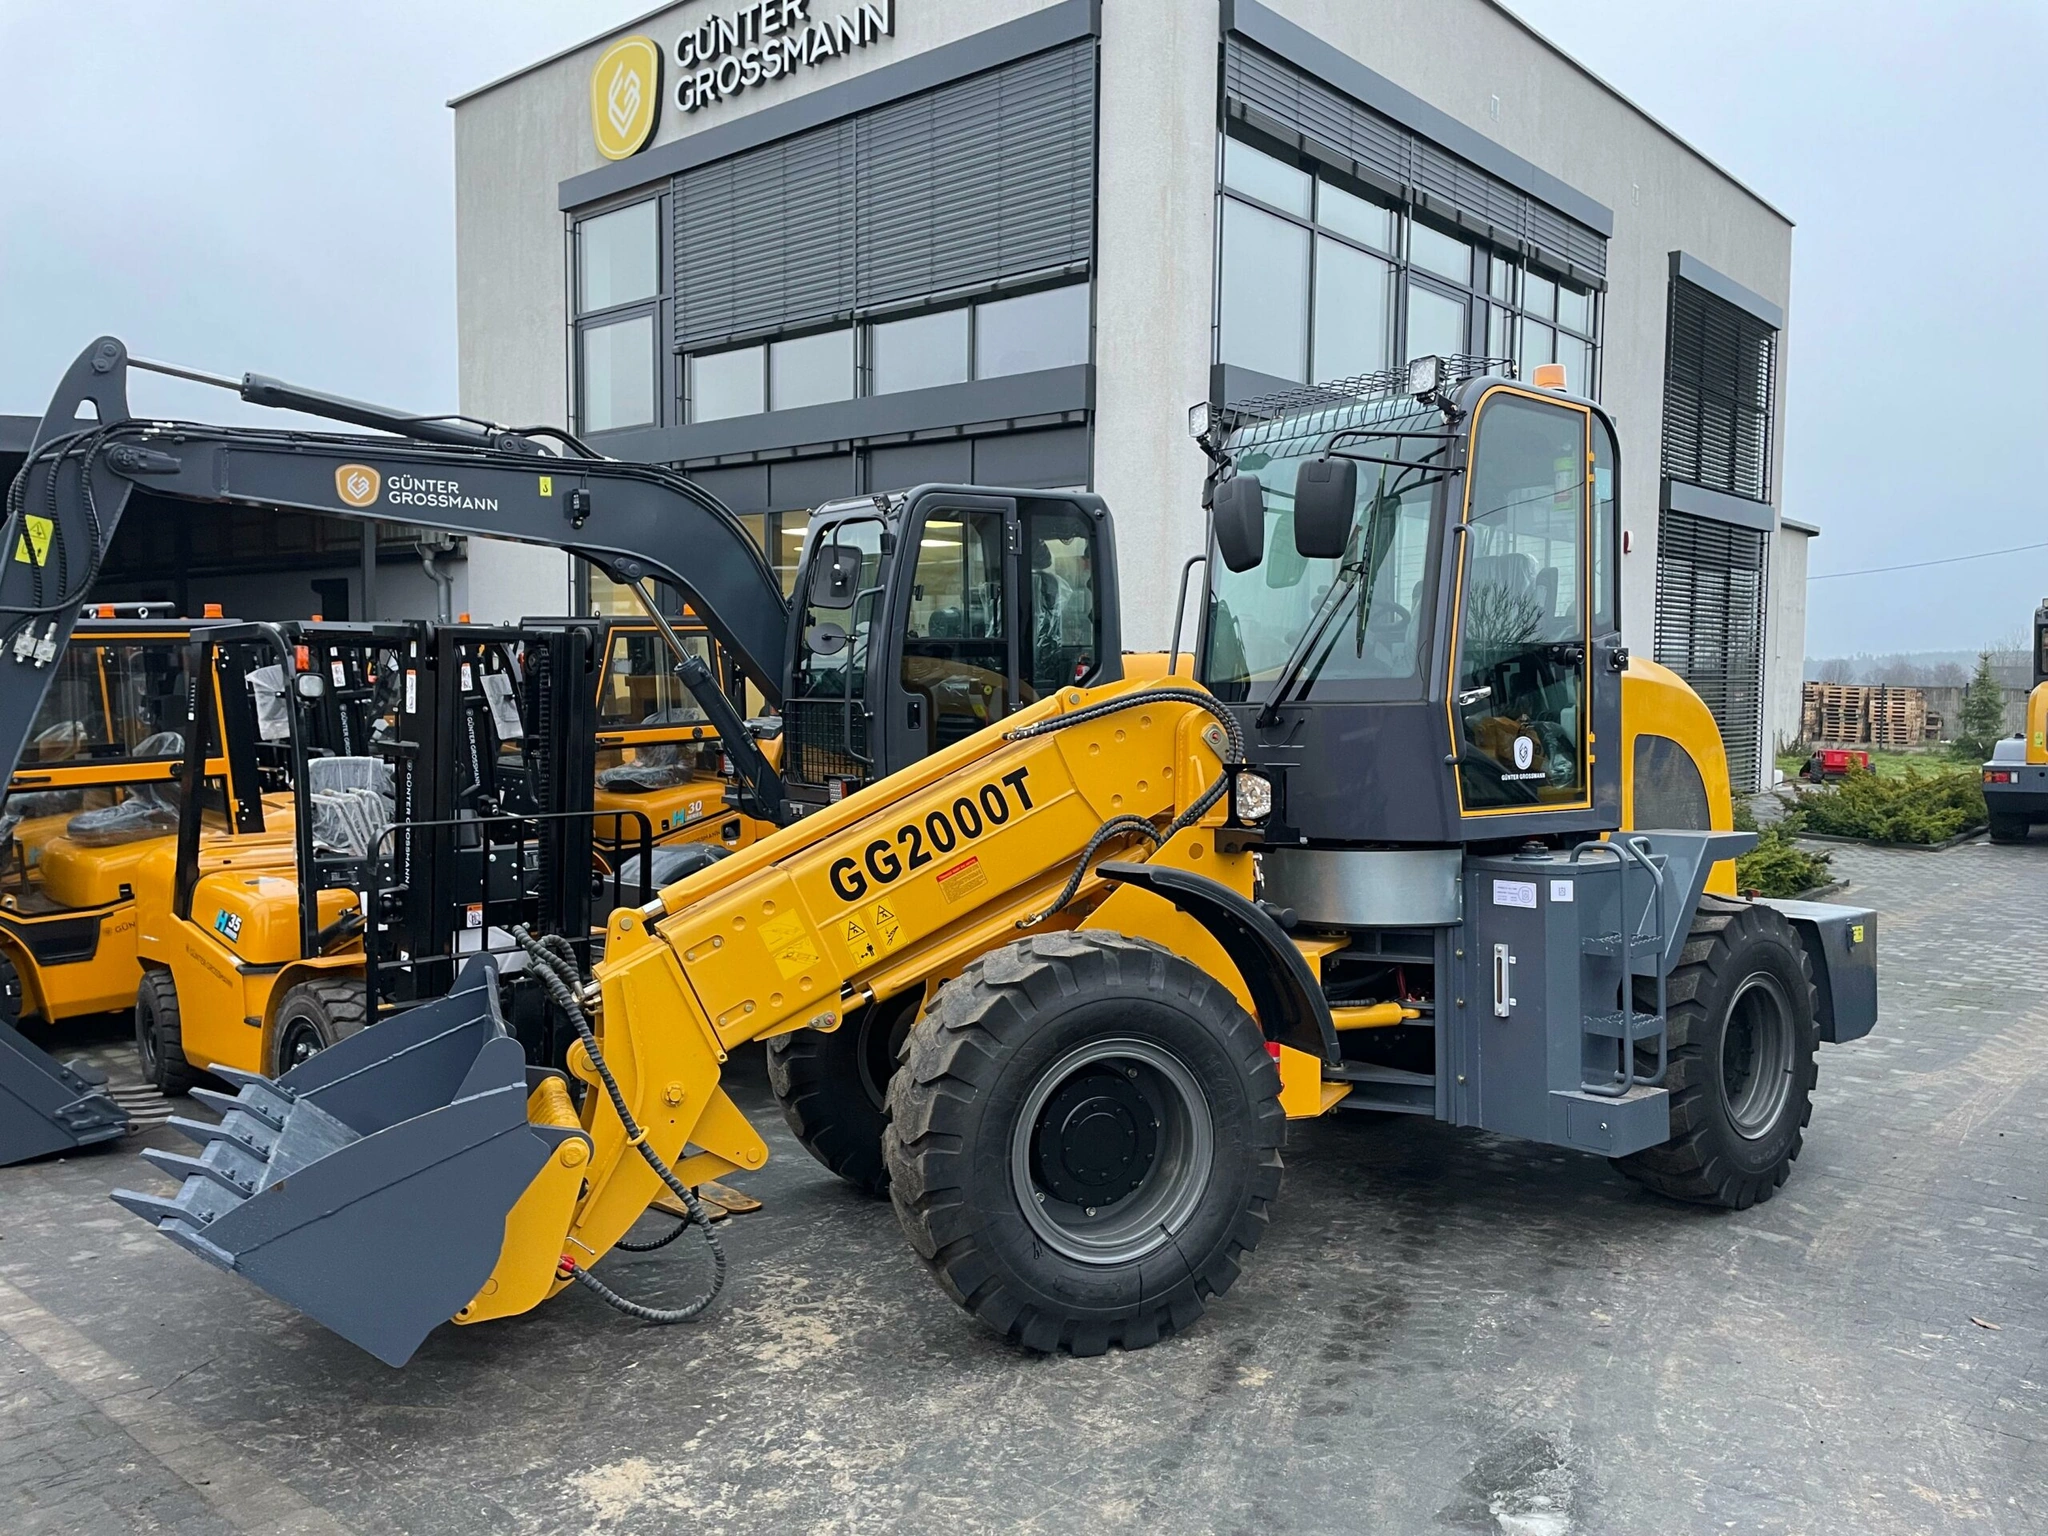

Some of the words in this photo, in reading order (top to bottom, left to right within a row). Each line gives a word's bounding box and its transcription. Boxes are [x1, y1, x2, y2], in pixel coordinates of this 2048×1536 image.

[673, 0, 806, 68] GÜNTER
[673, 0, 890, 112] GROSSMANN
[388, 474, 459, 494] GÜNTER
[388, 491, 498, 511] GROSSMANN
[688, 800, 702, 814] 30
[829, 766, 1034, 902] GG2000T
[115, 921, 136, 933] GÜN
[214, 909, 229, 933] H
[228, 913, 242, 932] 35
